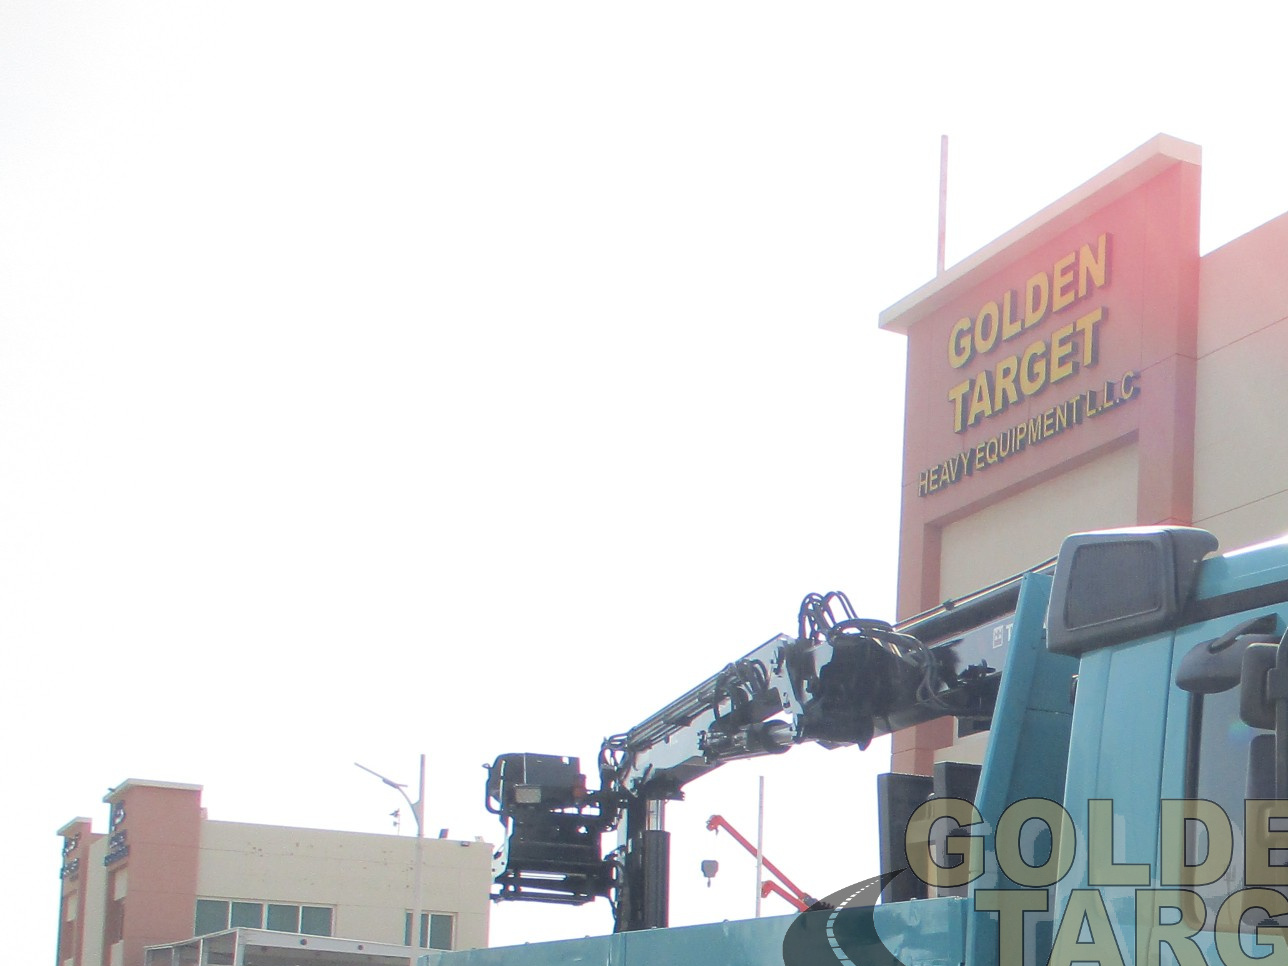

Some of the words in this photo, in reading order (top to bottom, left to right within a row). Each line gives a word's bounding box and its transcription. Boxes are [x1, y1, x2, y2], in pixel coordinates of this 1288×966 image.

[949, 232, 1110, 370] GOLDEN
[949, 306, 1106, 434] TARGET
[918, 447, 974, 498] HEAVY
[974, 394, 1083, 472] EQUIPMENT
